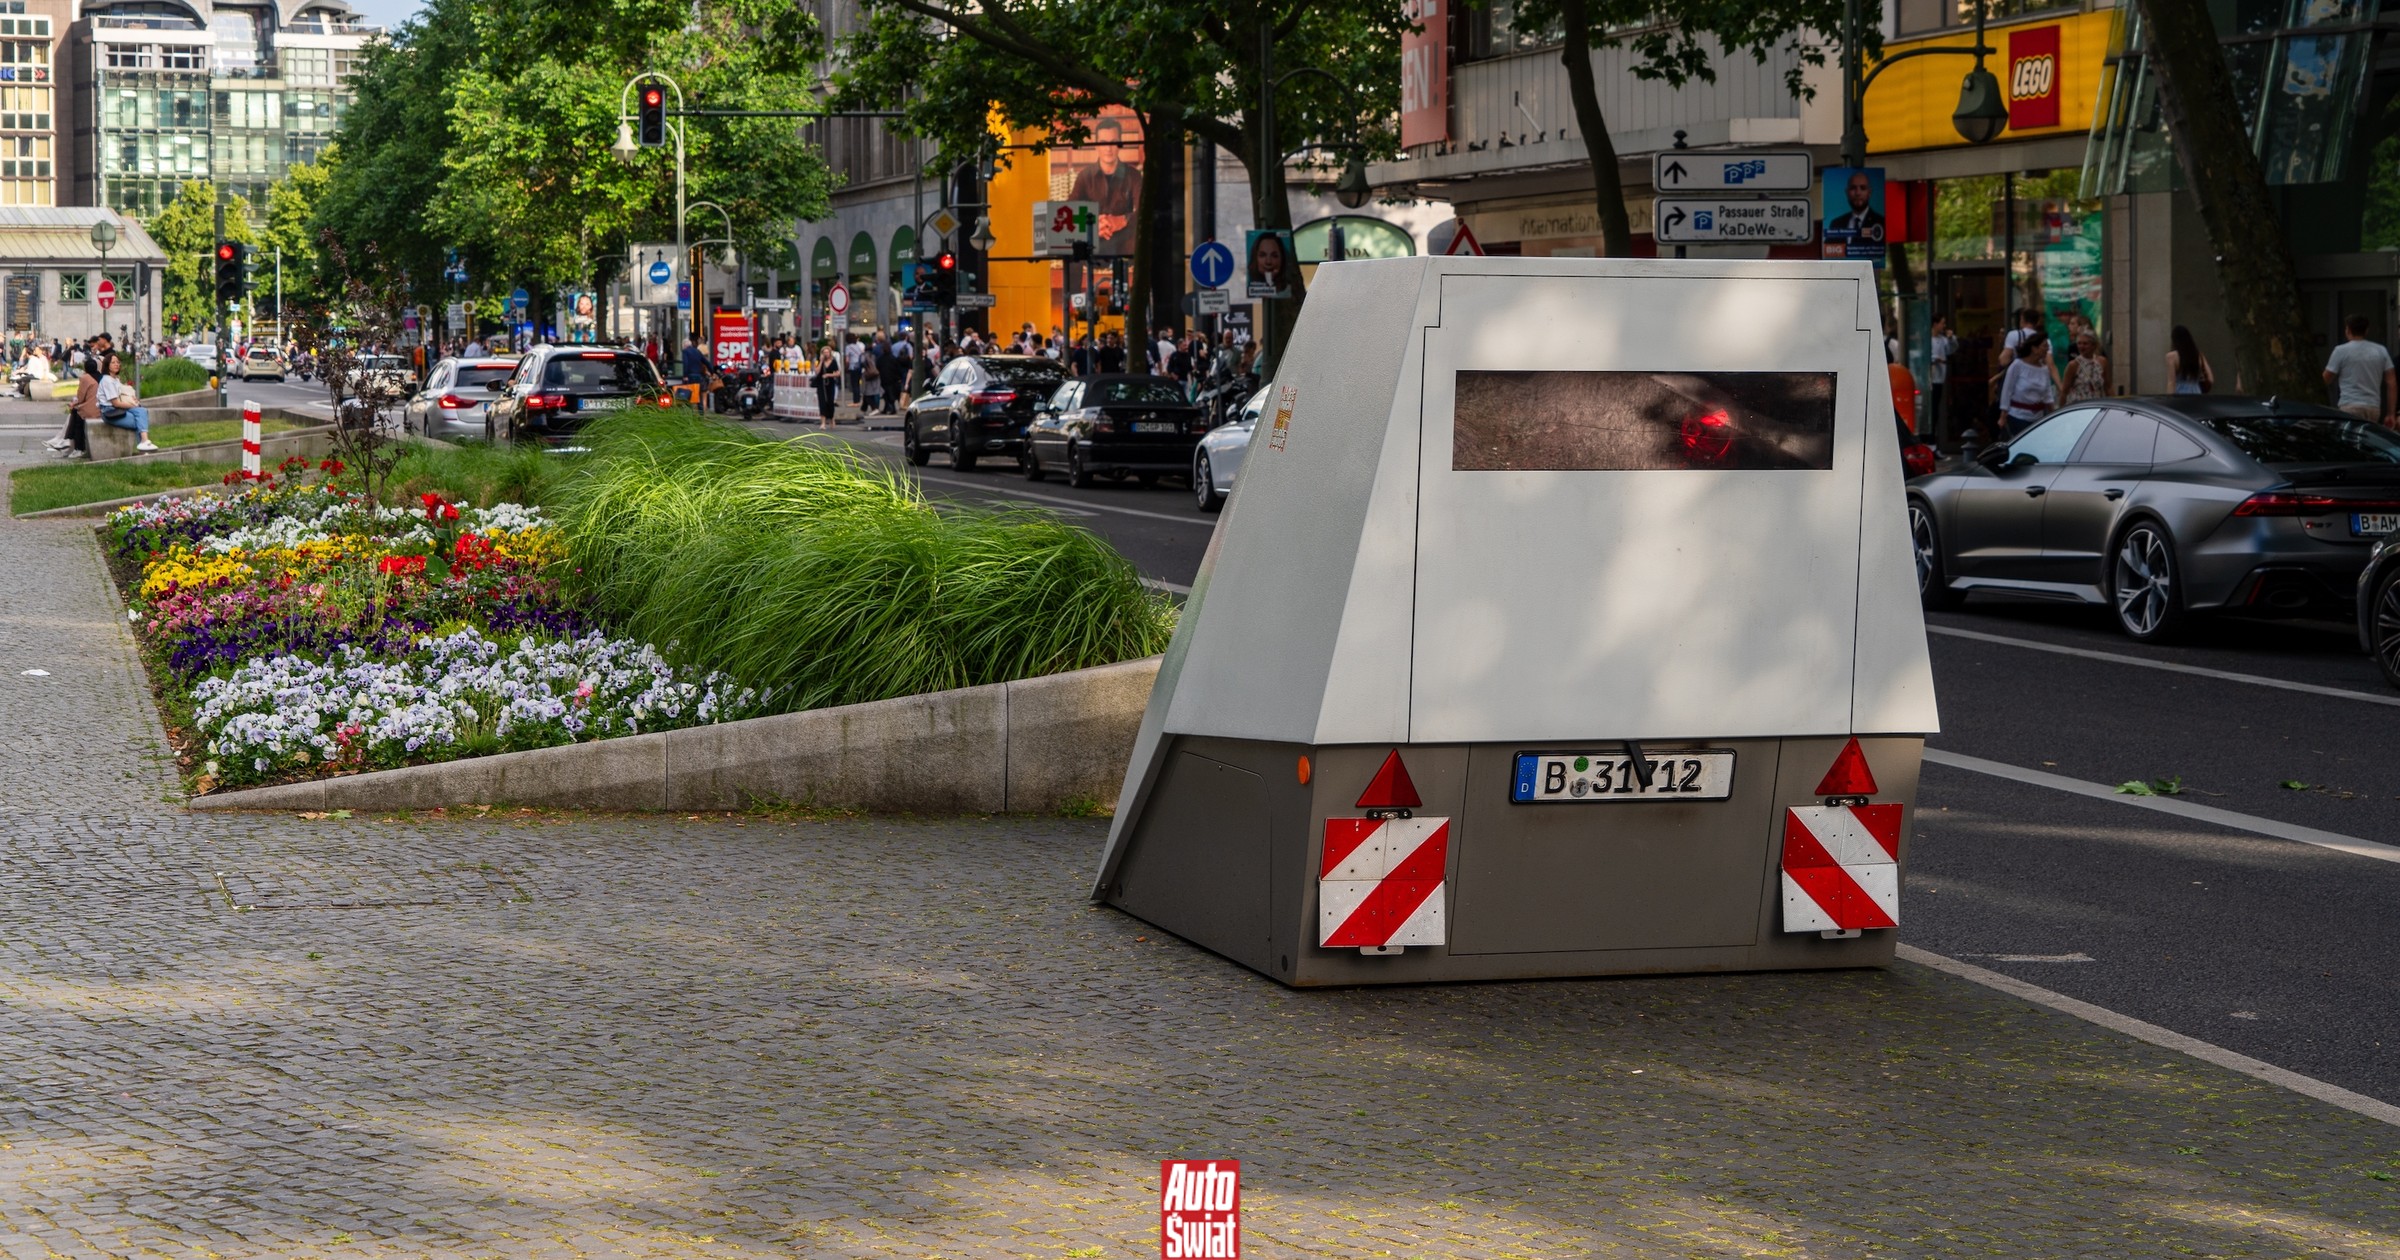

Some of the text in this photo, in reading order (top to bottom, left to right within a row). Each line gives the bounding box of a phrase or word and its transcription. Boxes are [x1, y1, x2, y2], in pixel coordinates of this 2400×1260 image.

[2013, 58, 2052, 96] LEGO
[1719, 205, 1804, 218] Passauer Straße
[1719, 223, 1775, 236] KaDeWe
[1324, 248, 1370, 257] PADA
[717, 341, 755, 358] SPD
[2361, 516, 2398, 530] B AM
[1544, 761, 1567, 794] B
